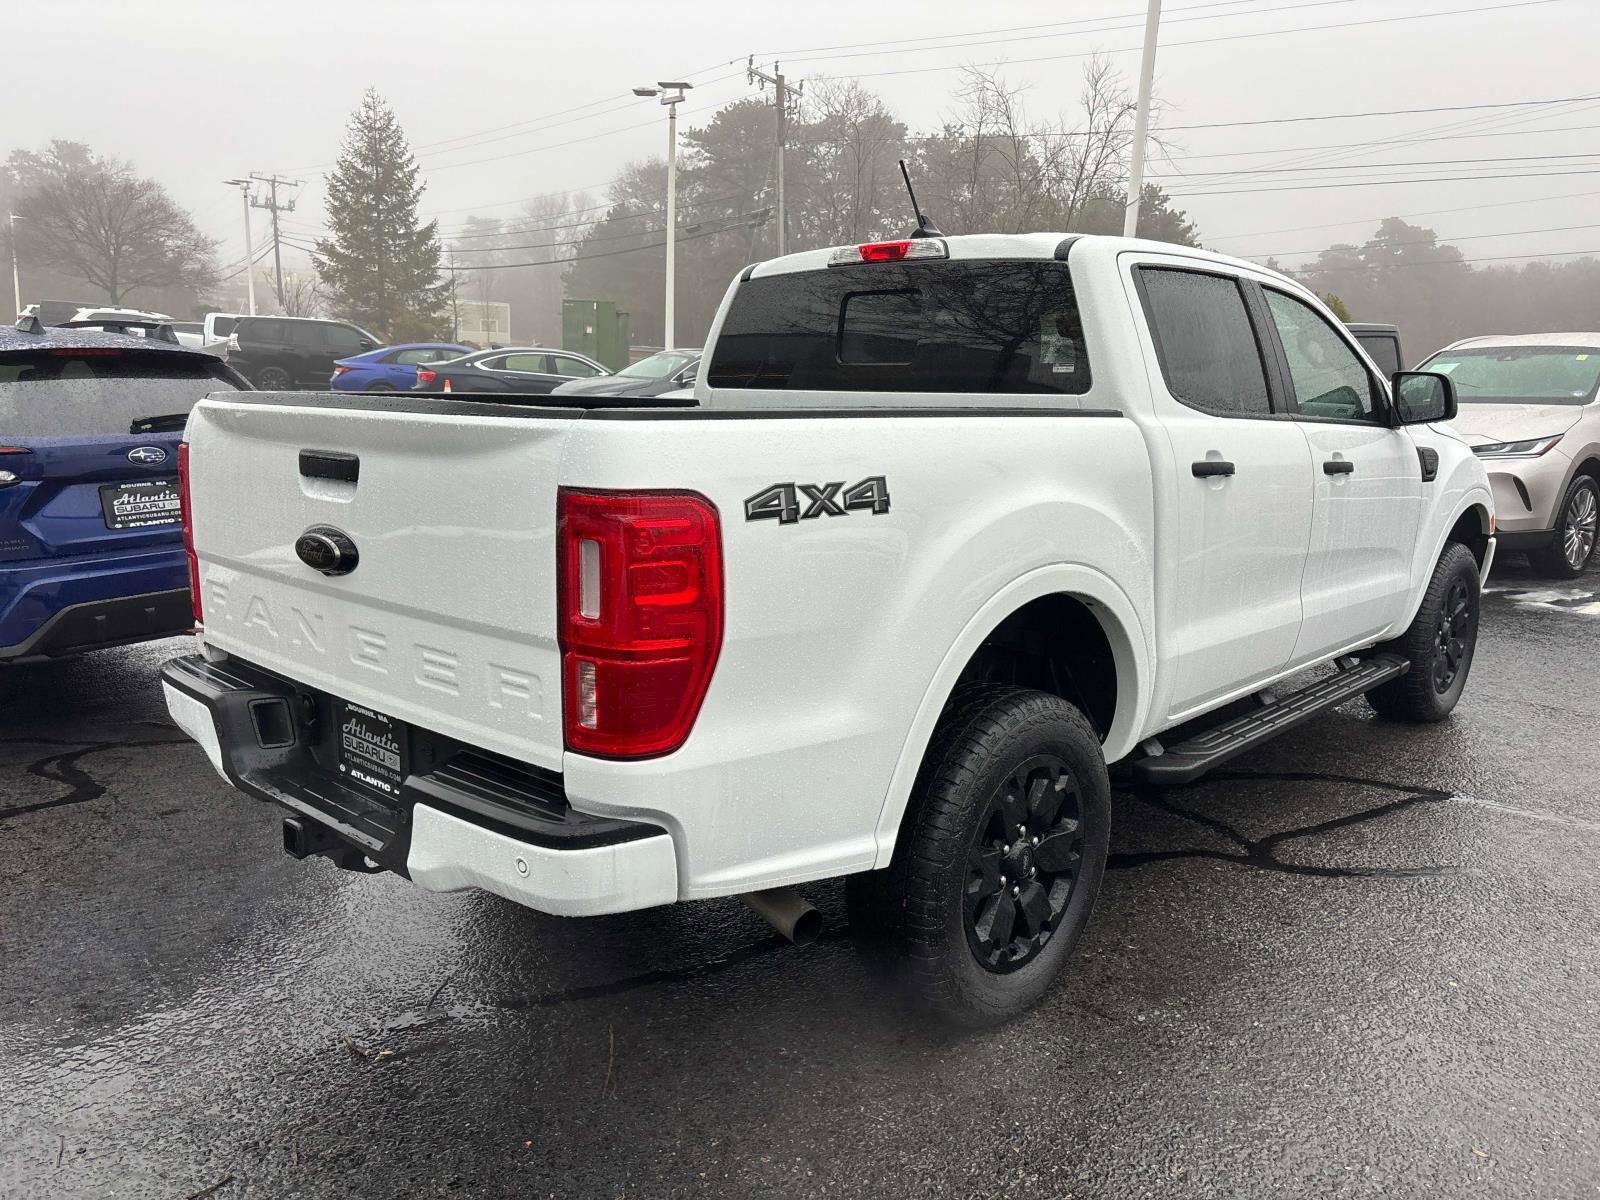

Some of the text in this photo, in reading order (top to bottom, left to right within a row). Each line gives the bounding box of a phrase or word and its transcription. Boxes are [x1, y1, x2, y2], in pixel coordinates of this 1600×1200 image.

[113, 490, 180, 505] Atlantic
[116, 502, 166, 514] SUBARU
[129, 518, 175, 527] ATLANTIC
[204, 578, 543, 721] RANGER
[342, 718, 400, 753] Atlantic
[344, 735, 386, 763] SUBARU
[351, 769, 391, 792] ATLANTIC
